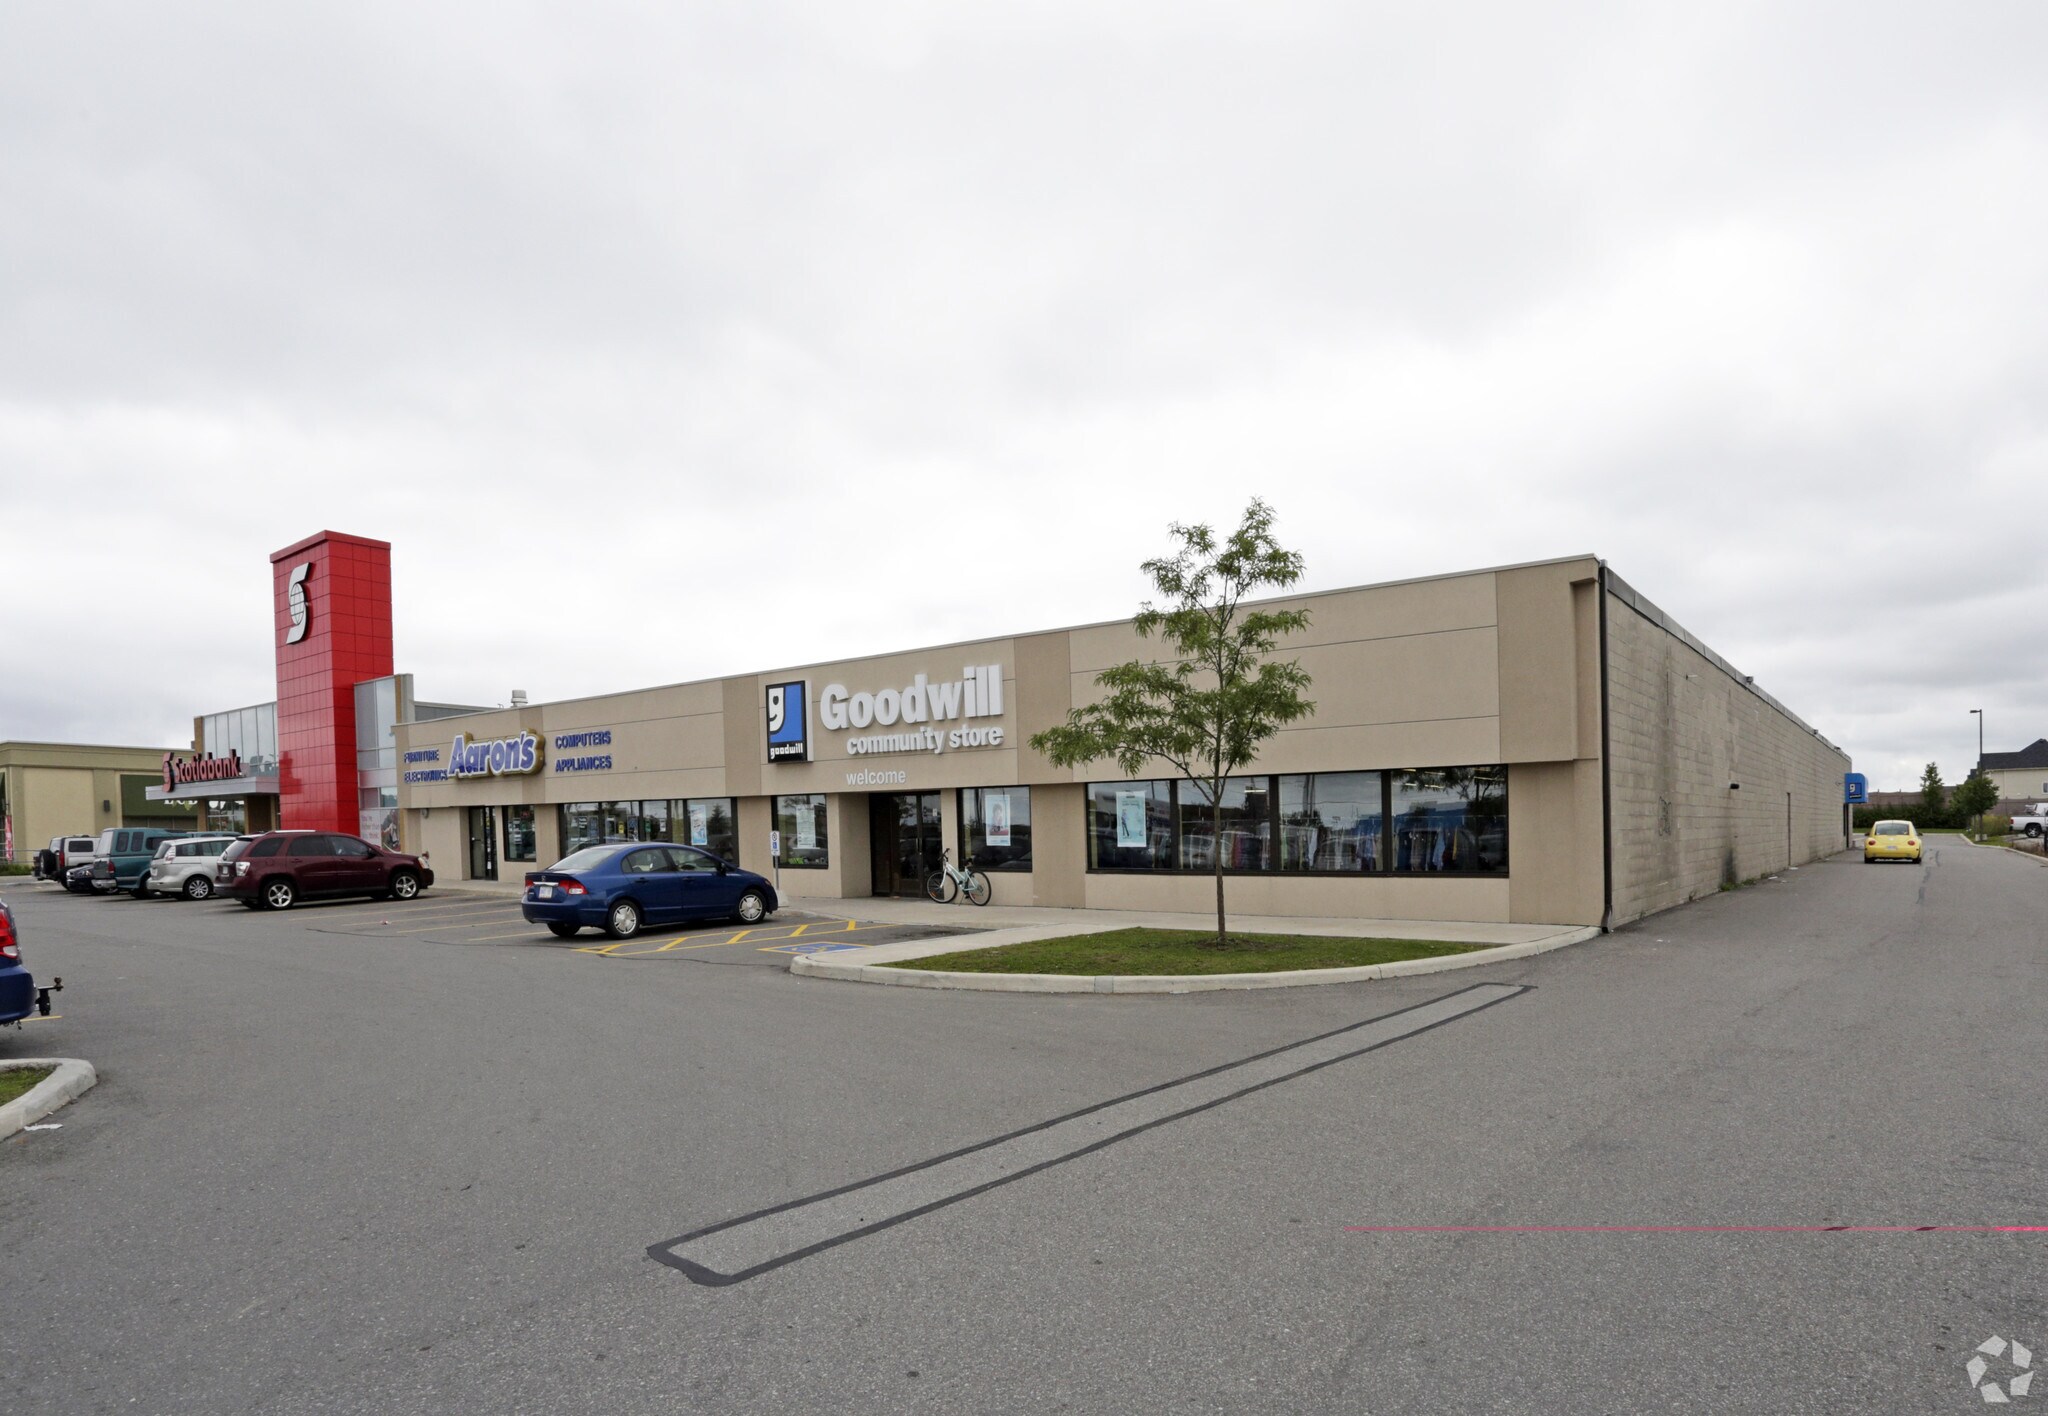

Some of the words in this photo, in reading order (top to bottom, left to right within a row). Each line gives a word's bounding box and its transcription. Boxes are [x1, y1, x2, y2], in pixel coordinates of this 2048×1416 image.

[820, 665, 1003, 730] Goodwill
[555, 731, 611, 749] COMPUTERS
[847, 726, 945, 755] community
[949, 724, 1004, 749] store
[404, 749, 440, 763] FURNITURE
[448, 730, 537, 778] Aaron's
[770, 743, 803, 759] goodwill
[173, 749, 241, 783] Scotiabank
[555, 755, 612, 772] APPLIANCES
[404, 769, 448, 784] ELECTRONICS
[846, 768, 907, 786] welcome
